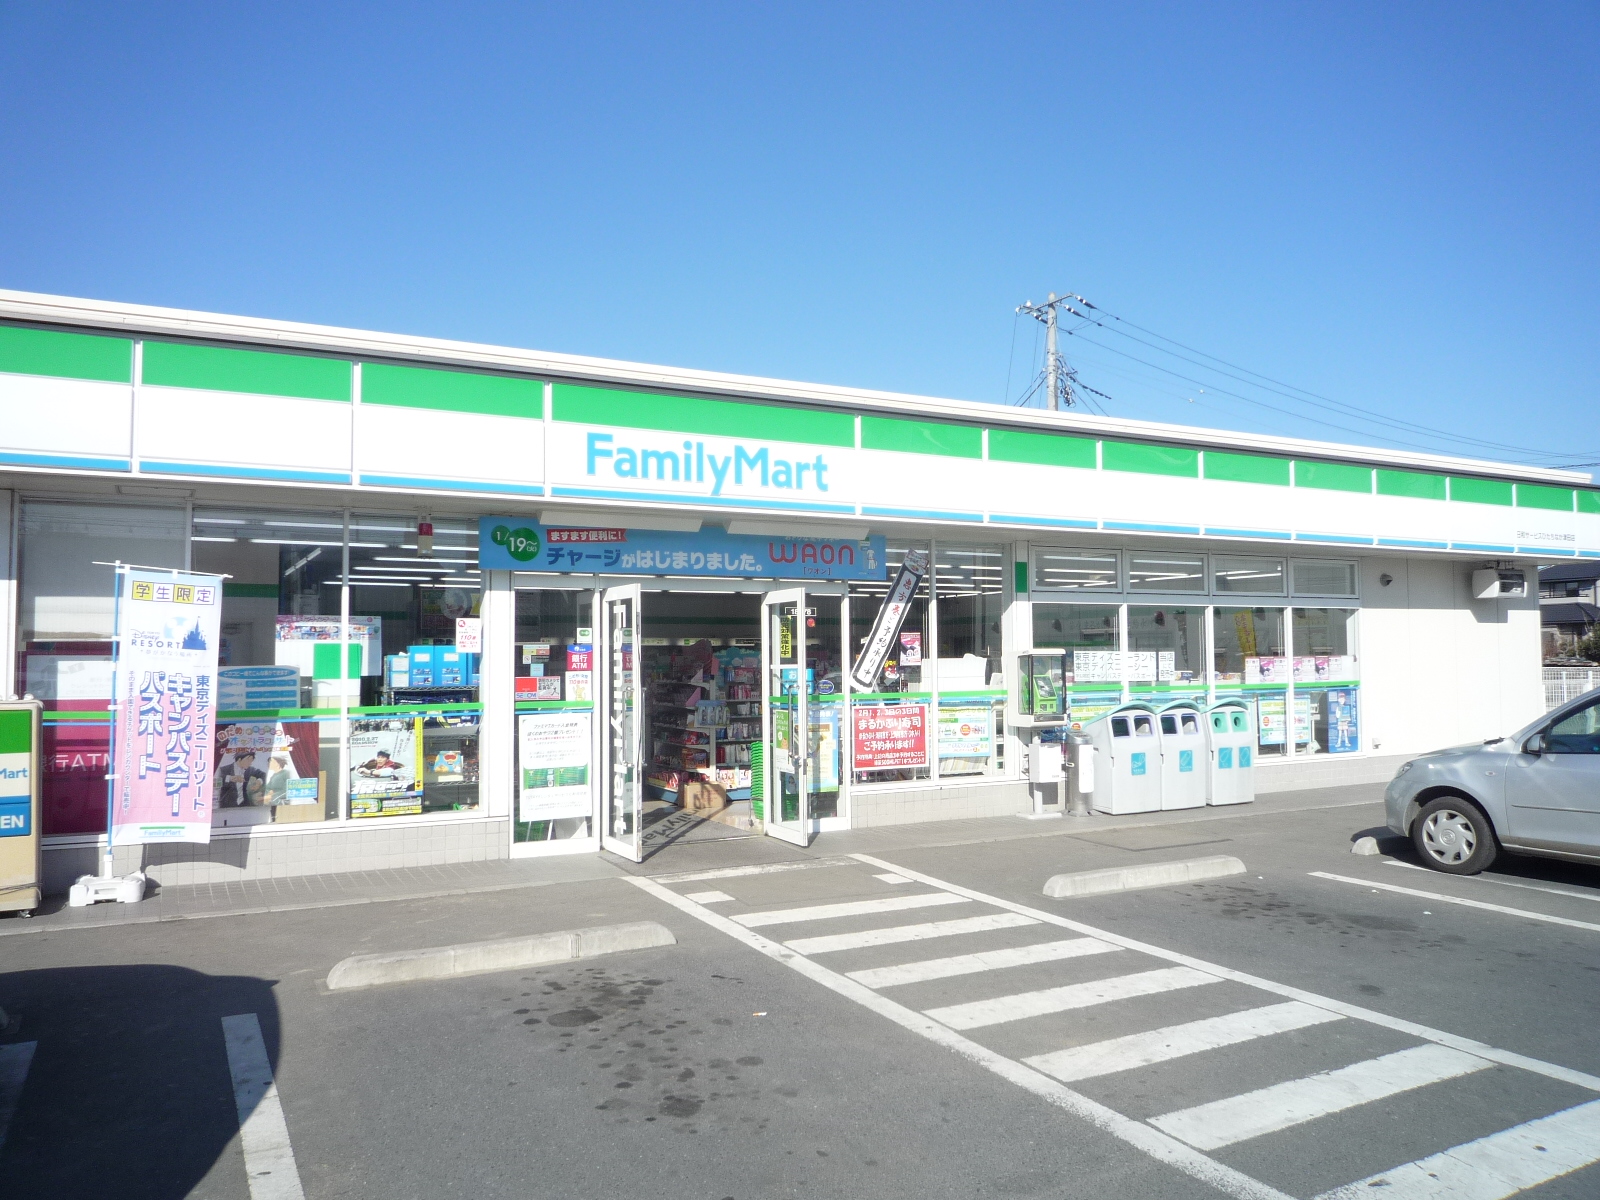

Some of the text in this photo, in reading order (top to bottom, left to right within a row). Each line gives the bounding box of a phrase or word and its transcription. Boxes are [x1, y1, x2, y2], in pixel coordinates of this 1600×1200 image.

[587, 432, 828, 496] FamilyMart
[546, 547, 763, 573] チャージがはじまりました。
[769, 542, 854, 565] WAON
[136, 583, 212, 603] 学生限定
[131, 638, 181, 649] RESORT
[571, 654, 588, 662] 銀行
[138, 670, 166, 780] パスポート
[858, 716, 921, 730] まるかぶり寿司
[165, 672, 193, 817] キャンパスデー
[193, 674, 210, 811] 東京ディズニーリゾート
[144, 829, 181, 837] FamilyMart
